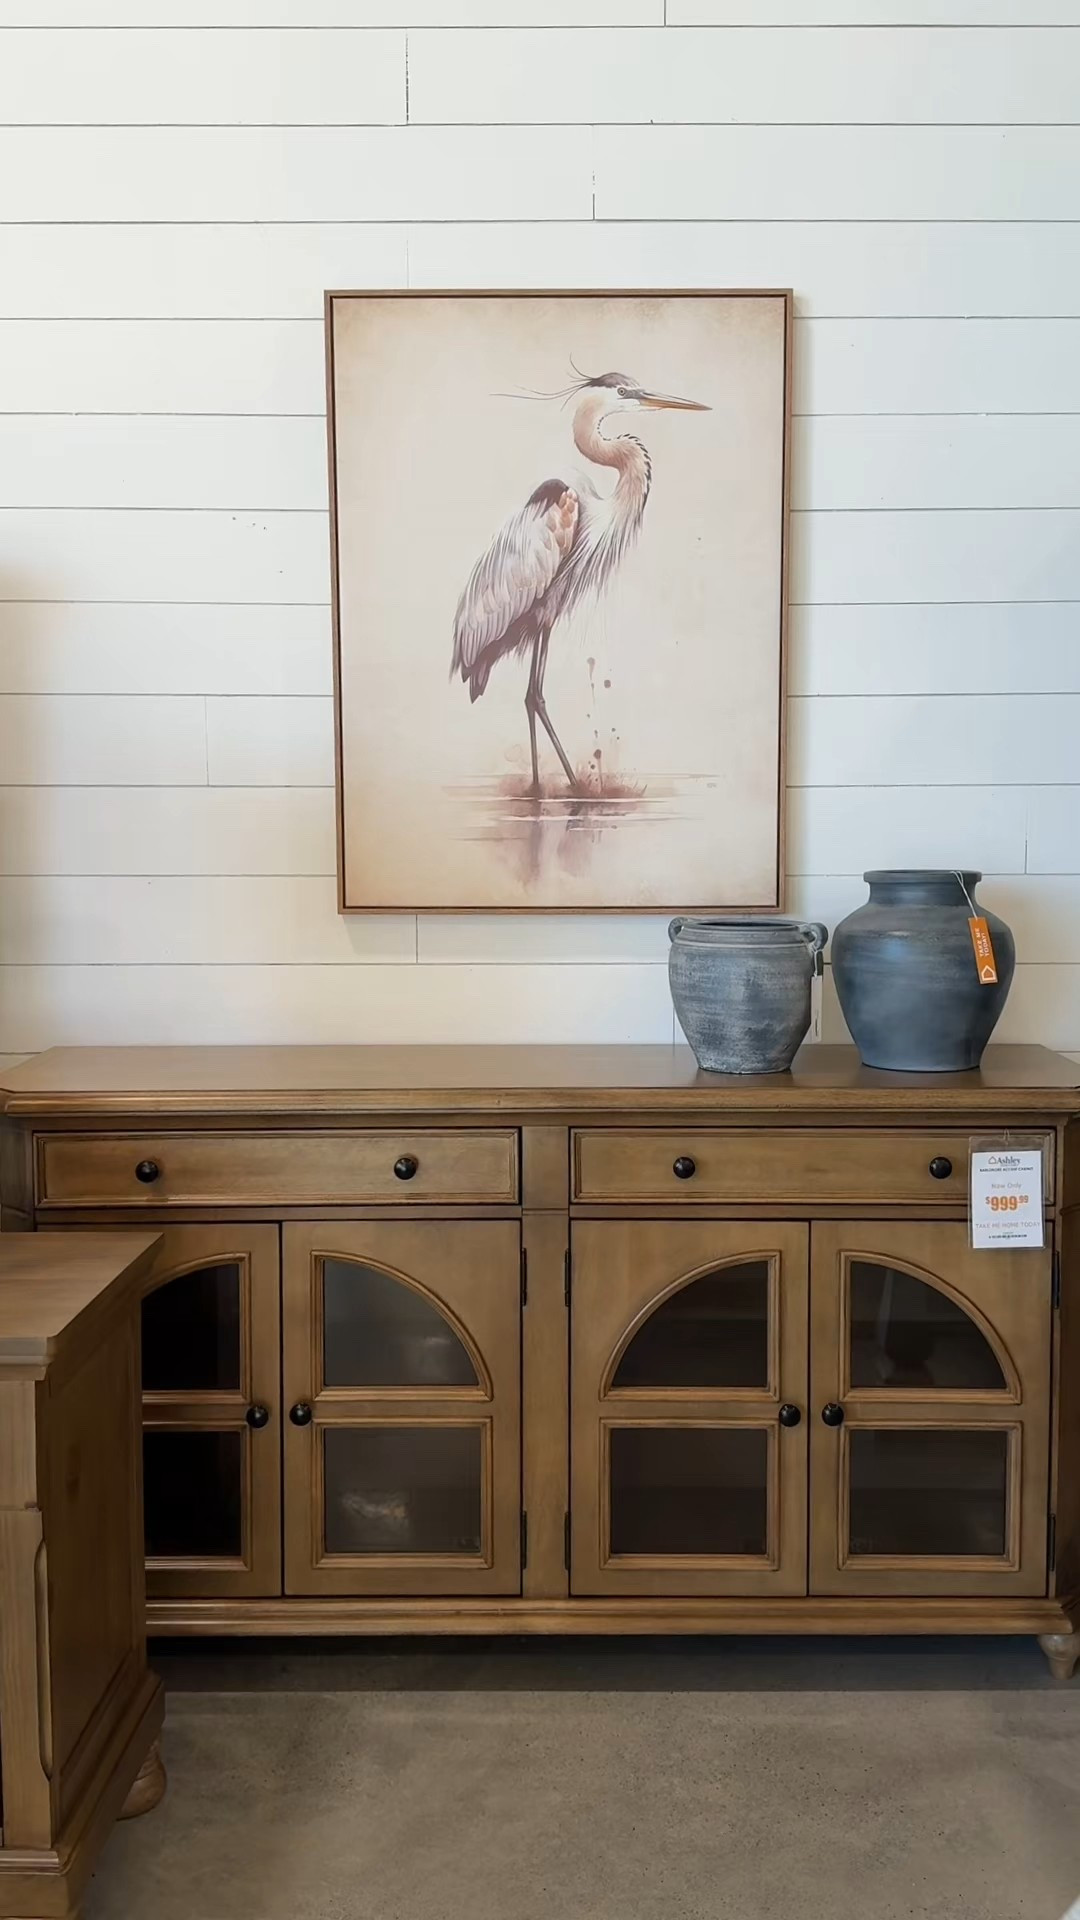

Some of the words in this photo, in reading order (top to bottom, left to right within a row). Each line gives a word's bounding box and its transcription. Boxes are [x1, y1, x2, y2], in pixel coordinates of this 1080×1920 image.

[975, 928, 981, 937] ME
[996, 1156, 1021, 1165] Ashley
[1007, 1181, 1022, 1190] Only
